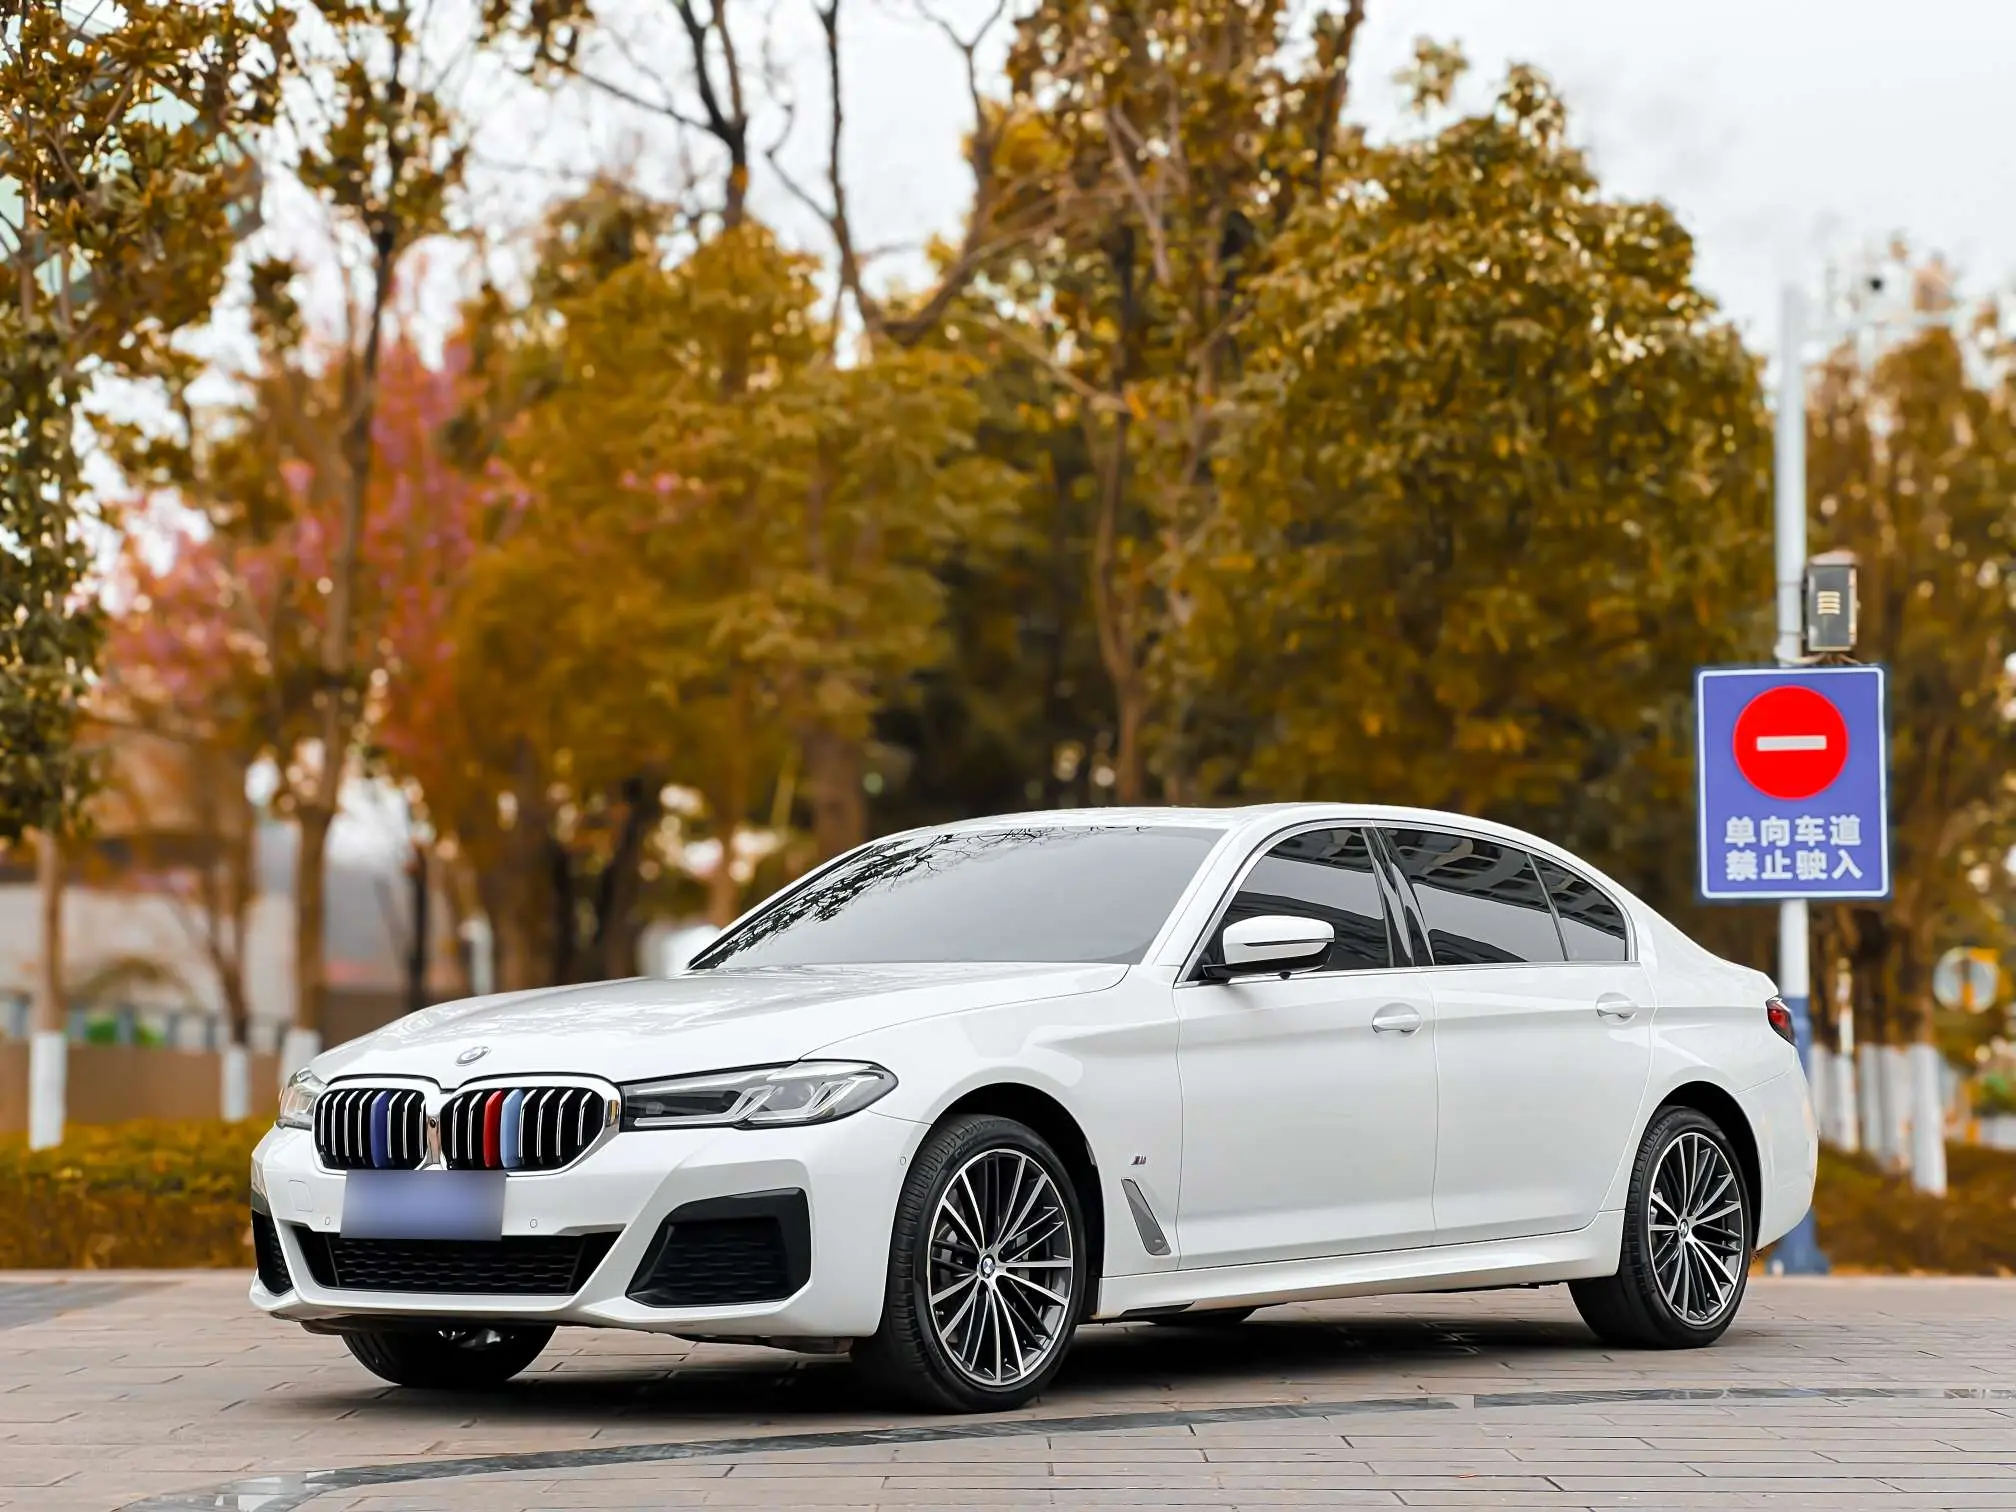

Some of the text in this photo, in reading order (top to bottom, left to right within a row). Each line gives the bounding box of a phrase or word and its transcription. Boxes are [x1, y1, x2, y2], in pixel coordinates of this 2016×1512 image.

[1725, 815, 1861, 847] 单向车道
[1726, 849, 1863, 881] 禁止驶入
